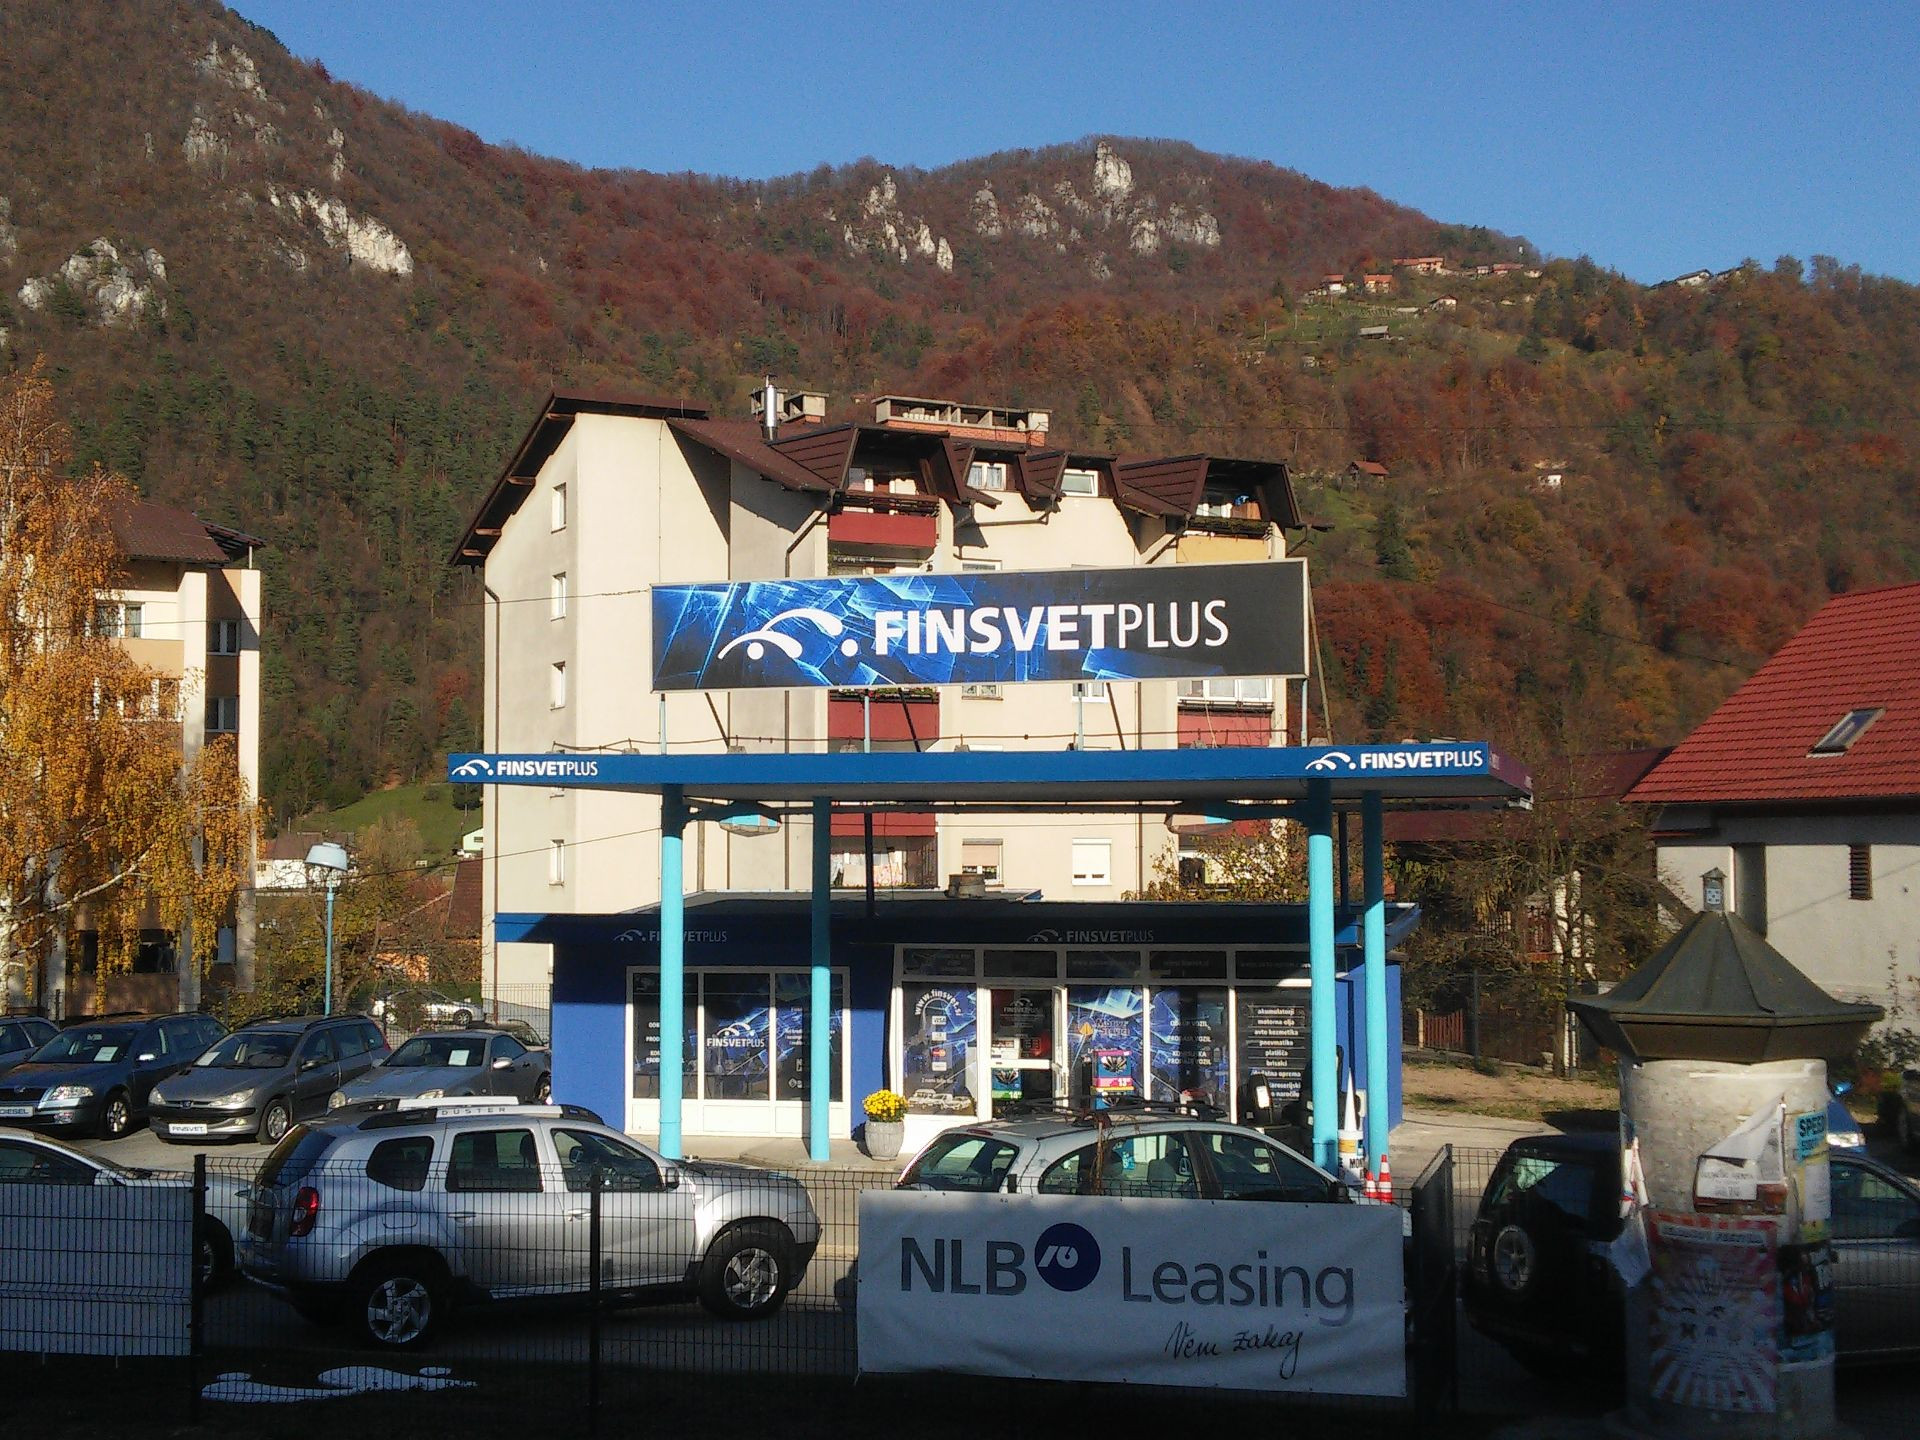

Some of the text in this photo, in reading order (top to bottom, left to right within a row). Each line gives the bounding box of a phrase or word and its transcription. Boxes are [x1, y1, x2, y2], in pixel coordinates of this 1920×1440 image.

[874, 599, 1229, 655] FINSVETPLUS
[1360, 750, 1483, 769] FINSVETPLUS
[497, 760, 598, 776] FINSVETPLUS
[1066, 929, 1154, 943] FINSVETPLUS
[1257, 1008, 1295, 1016] akumulatorji
[706, 1037, 765, 1048] FINSVETPLUS
[441, 1107, 507, 1116] DUSTER
[900, 1237, 1355, 1328] NLB Leasing
[1163, 1320, 1220, 1361] Vem
